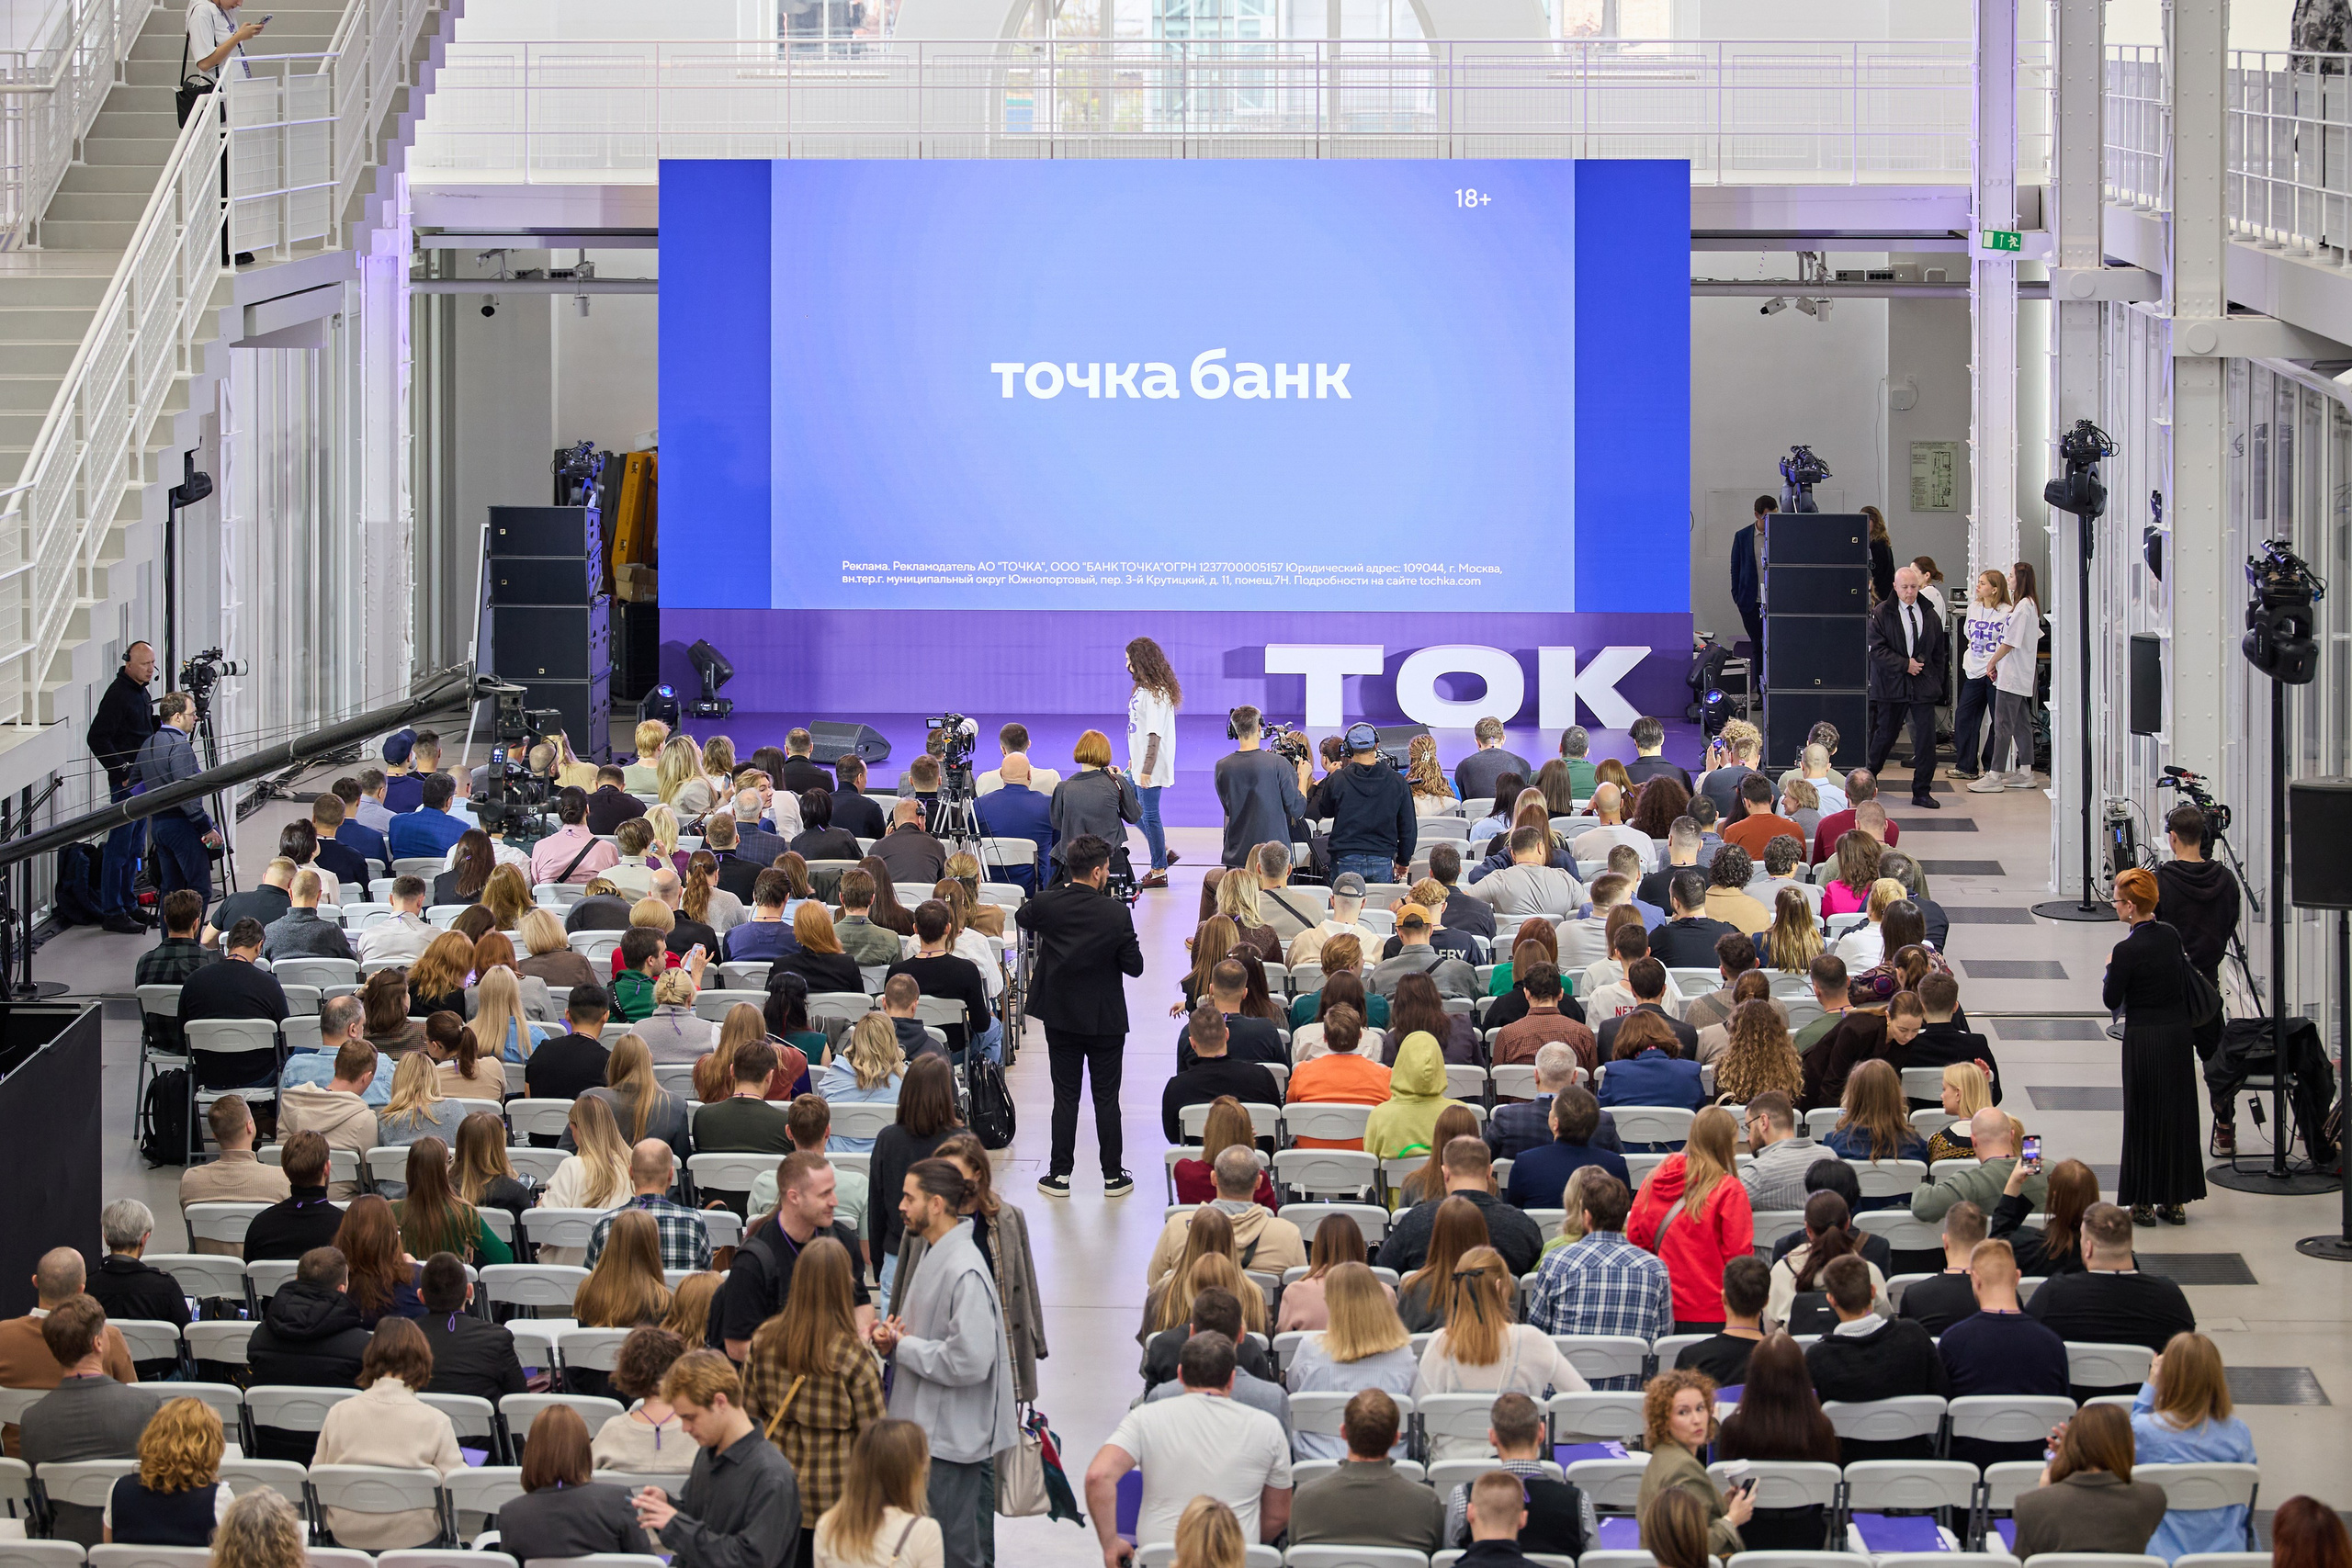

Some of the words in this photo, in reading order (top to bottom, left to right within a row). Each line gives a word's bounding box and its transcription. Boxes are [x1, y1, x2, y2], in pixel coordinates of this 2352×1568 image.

[1454, 188, 1492, 208] 18+
[990, 361, 1180, 400] точка
[1190, 347, 1352, 400] банк
[842, 560, 890, 571] Реклама.
[893, 560, 976, 572] Рекламодатель
[978, 561, 996, 571] АО
[997, 561, 1047, 573] "ТОЧКА",
[1050, 561, 1080, 571] ООО
[1199, 562, 1283, 572] 1237700005157
[1286, 563, 1363, 574] Юридический
[1366, 564, 1401, 575] адрес:
[1404, 563, 1447, 574] 109044,
[1458, 563, 1503, 574] Москва,
[842, 575, 885, 585] вн.тер.г.
[887, 574, 974, 586] муниципальный
[975, 576, 1007, 586] округ
[1008, 574, 1098, 586] Южнопортовый,
[1100, 576, 1123, 586] пер.
[1125, 574, 1144, 584] 3-й
[1146, 574, 1208, 586] Крутицкий,
[1209, 576, 1219, 586] д.
[1221, 575, 1233, 586] 11,
[1235, 575, 1292, 586] помещ.7Н.
[1294, 575, 1369, 587] Подробности
[1385, 576, 1418, 585] сайте
[1419, 576, 1482, 586] tochka.com
[1265, 643, 1652, 729] ТОК
[1615, 1006, 1637, 1017] NET
